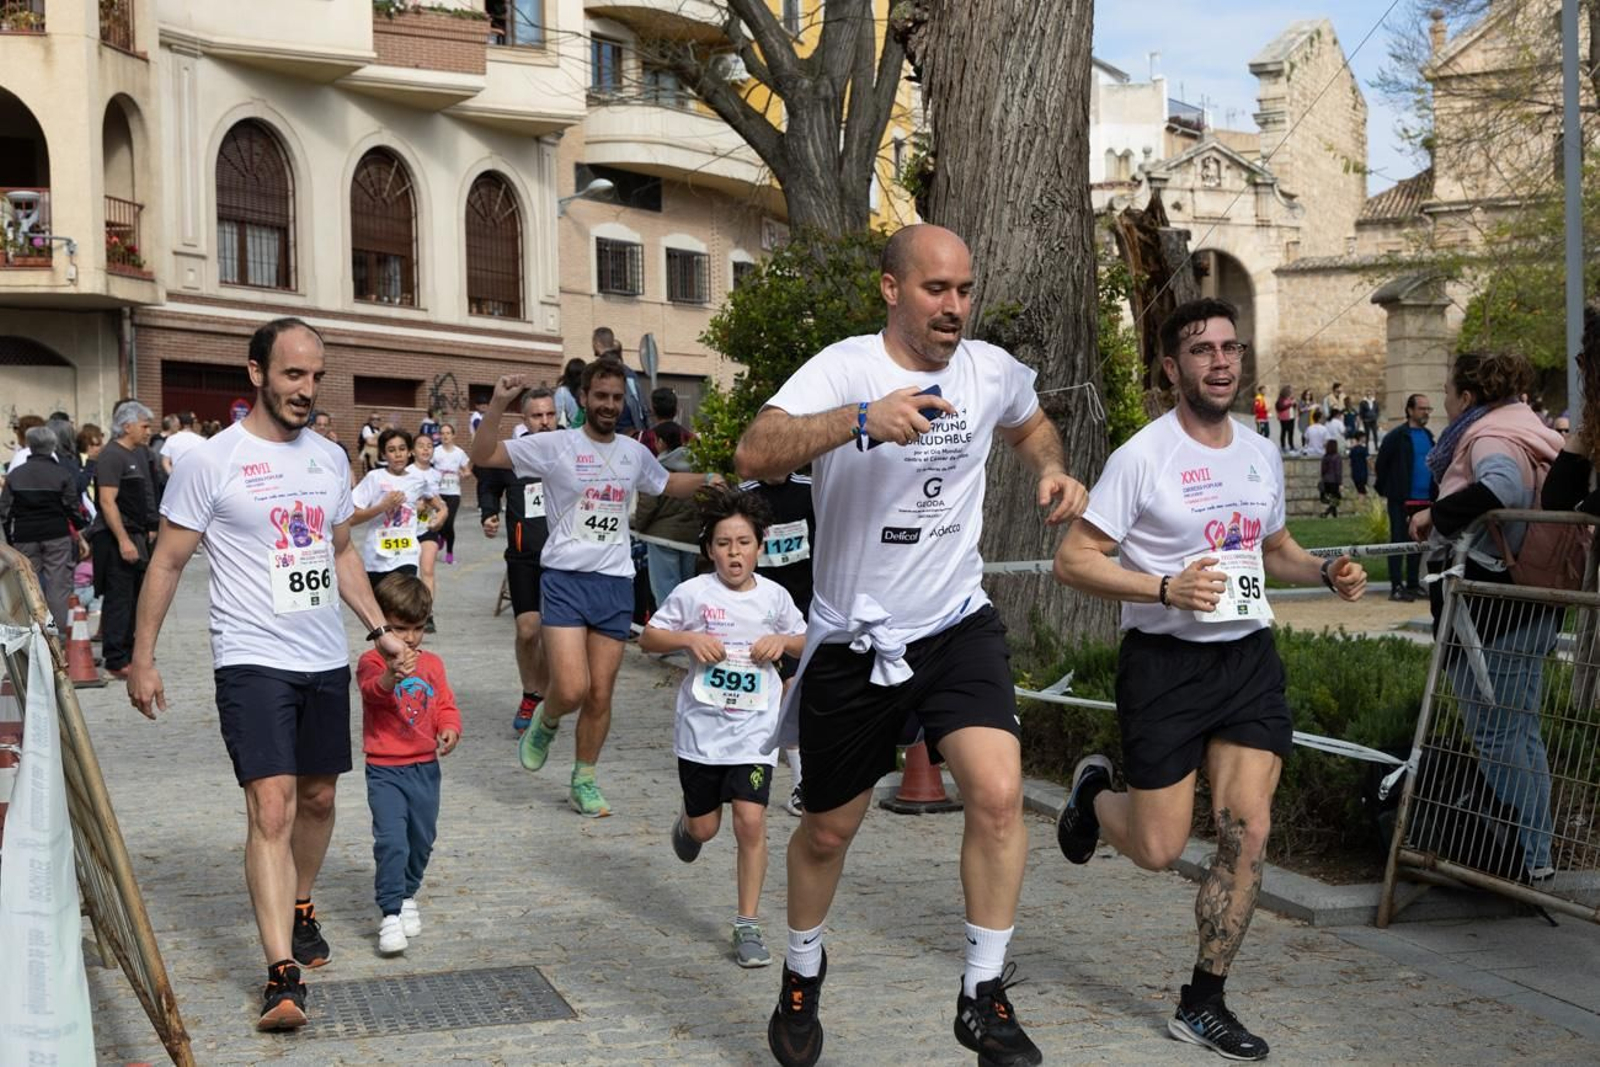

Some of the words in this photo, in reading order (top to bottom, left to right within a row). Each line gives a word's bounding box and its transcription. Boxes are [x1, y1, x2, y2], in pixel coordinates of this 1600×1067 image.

[243, 462, 271, 477] XXVII
[1181, 468, 1211, 485] XXVII
[923, 477, 943, 499] G
[532, 495, 545, 506] 4
[917, 500, 946, 508] GEODA
[585, 516, 619, 532] 442
[384, 538, 410, 549] 519
[289, 568, 331, 593] 866
[1238, 575, 1261, 599] 95
[709, 668, 756, 693] 593
